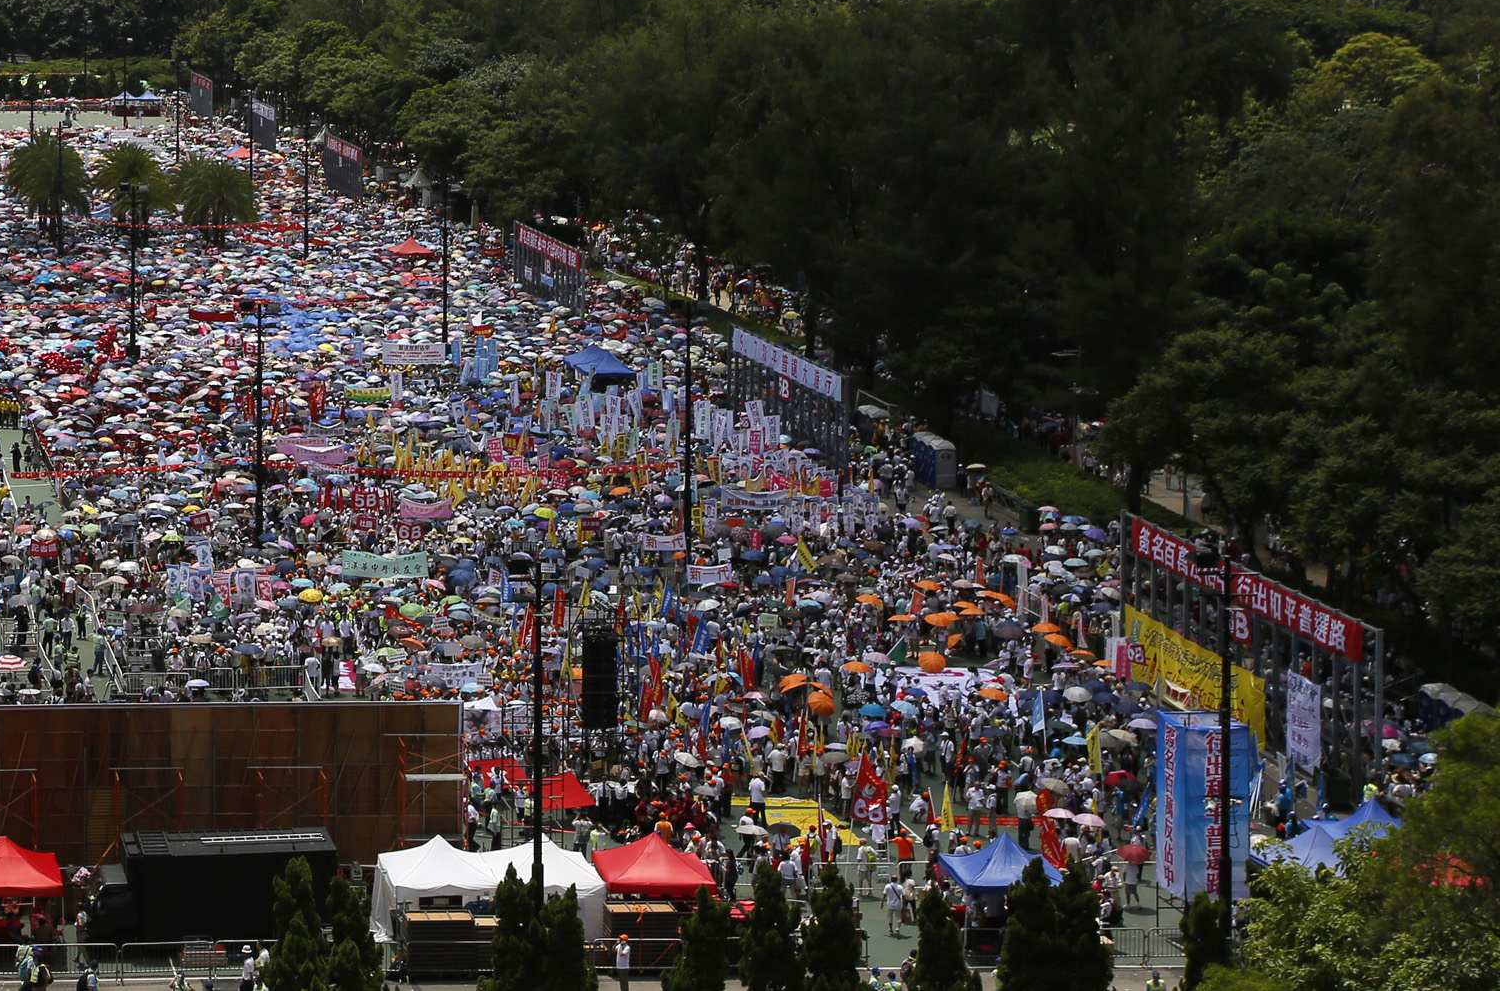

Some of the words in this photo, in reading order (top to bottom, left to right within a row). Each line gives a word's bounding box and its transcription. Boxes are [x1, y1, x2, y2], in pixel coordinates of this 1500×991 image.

[354, 493, 377, 508] 5B
[399, 525, 421, 540] 6B
[645, 534, 684, 549] 新一代
[689, 566, 730, 582] 新一代
[1237, 574, 1347, 653] 行出和平普選路
